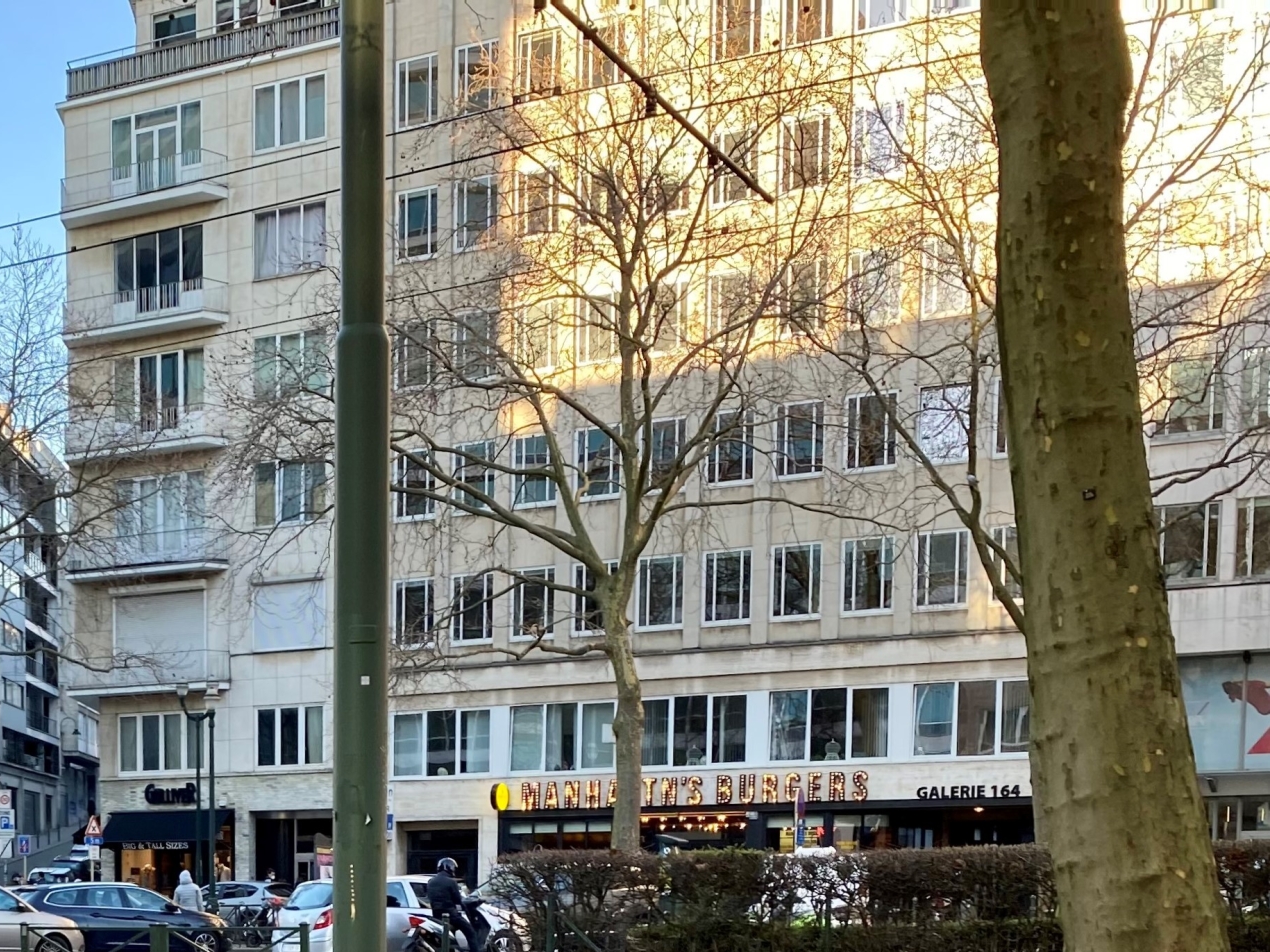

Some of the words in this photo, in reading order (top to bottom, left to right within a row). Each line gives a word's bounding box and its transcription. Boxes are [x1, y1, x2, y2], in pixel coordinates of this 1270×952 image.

[521, 775, 703, 811] MANHATN'S
[716, 771, 869, 804] BURGERS
[917, 785, 986, 799] GALERIE
[991, 785, 1021, 797] 164
[146, 842, 164, 850] TALL
[165, 841, 189, 850] SIZES
